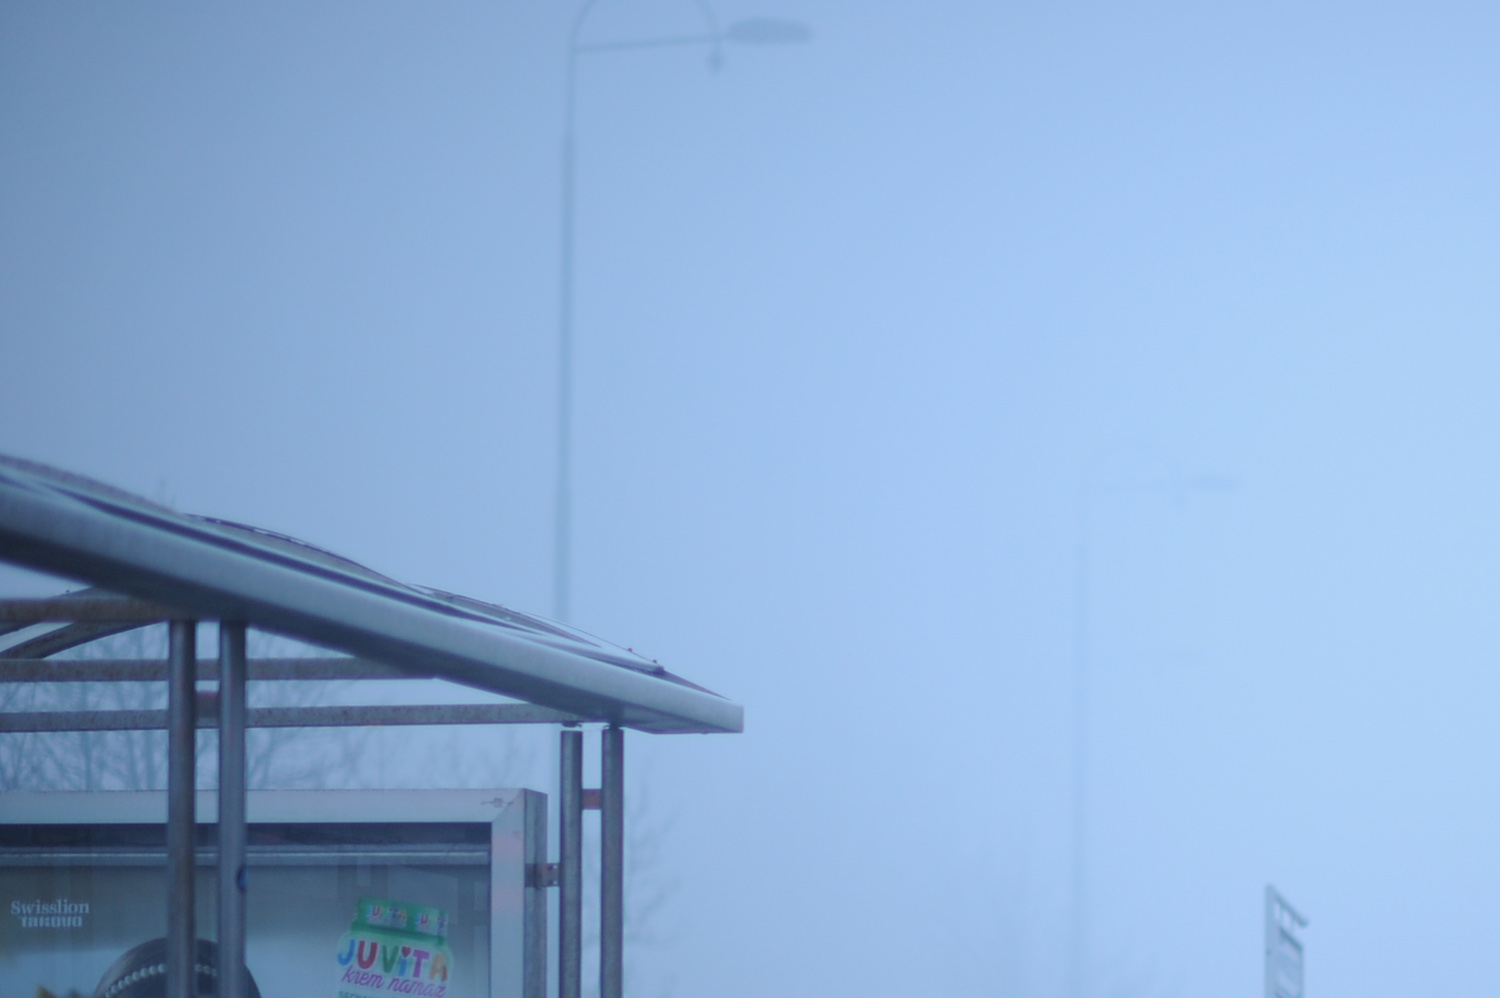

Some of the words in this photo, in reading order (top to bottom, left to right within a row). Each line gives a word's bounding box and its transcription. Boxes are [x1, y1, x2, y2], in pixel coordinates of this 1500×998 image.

[11, 899, 90, 915] Swisslion
[341, 965, 384, 989] krem
[387, 976, 447, 998] namaz
